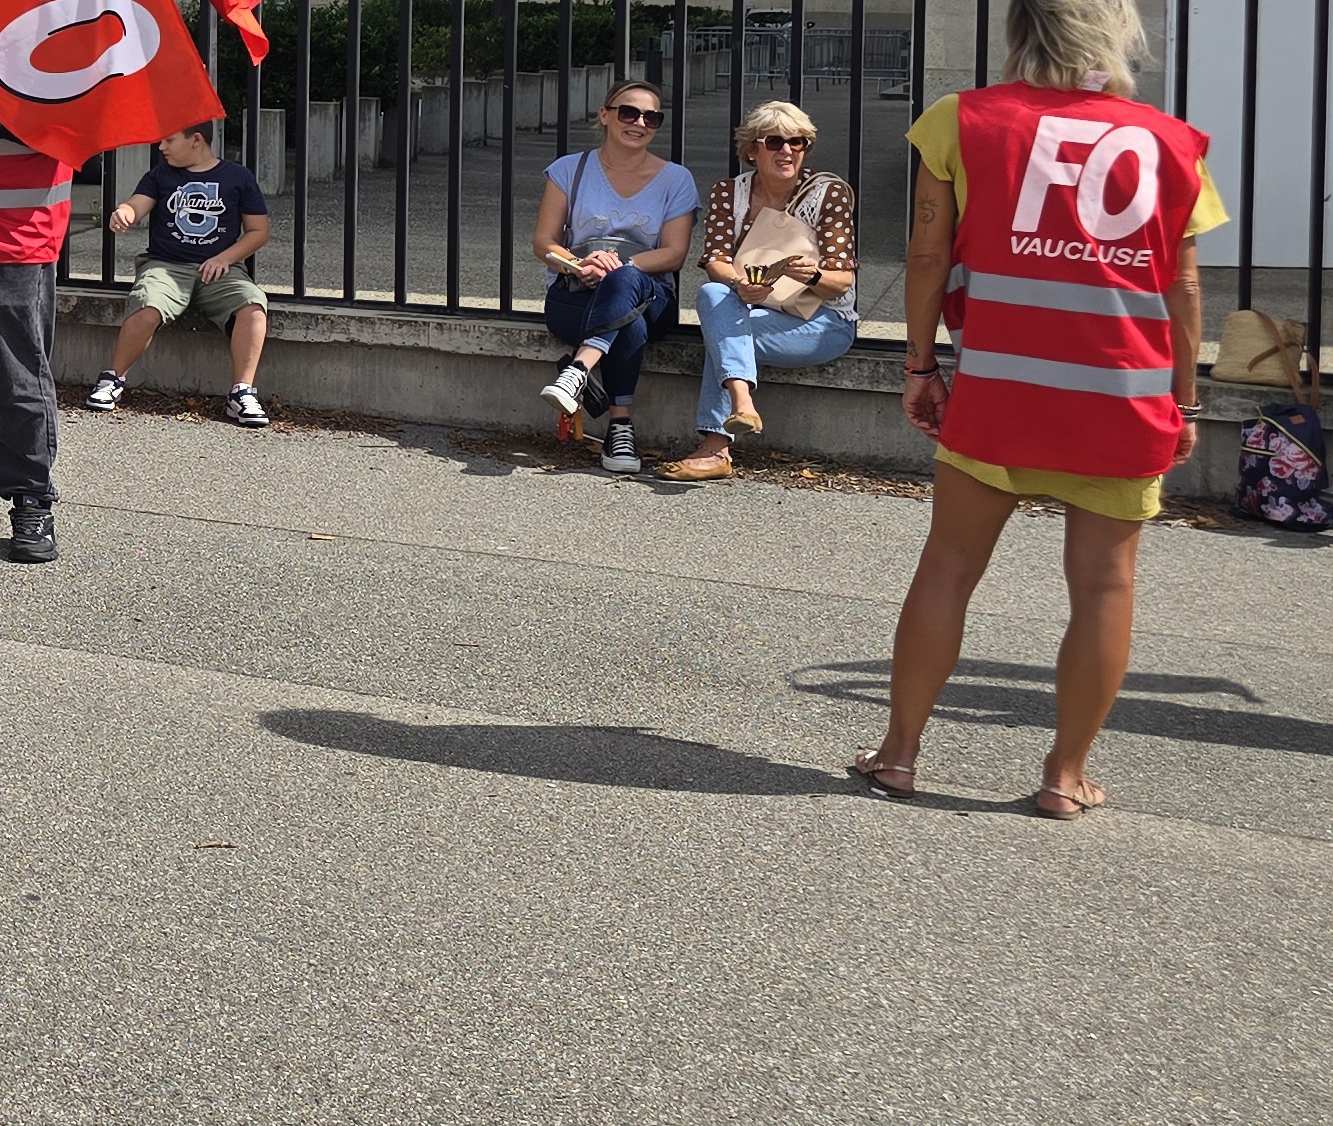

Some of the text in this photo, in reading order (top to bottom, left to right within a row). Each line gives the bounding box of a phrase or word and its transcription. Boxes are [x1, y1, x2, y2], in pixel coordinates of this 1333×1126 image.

[1012, 115, 1159, 241] FO
[167, 186, 226, 217] Champs
[1010, 236, 1153, 267] VAUCLUSE
